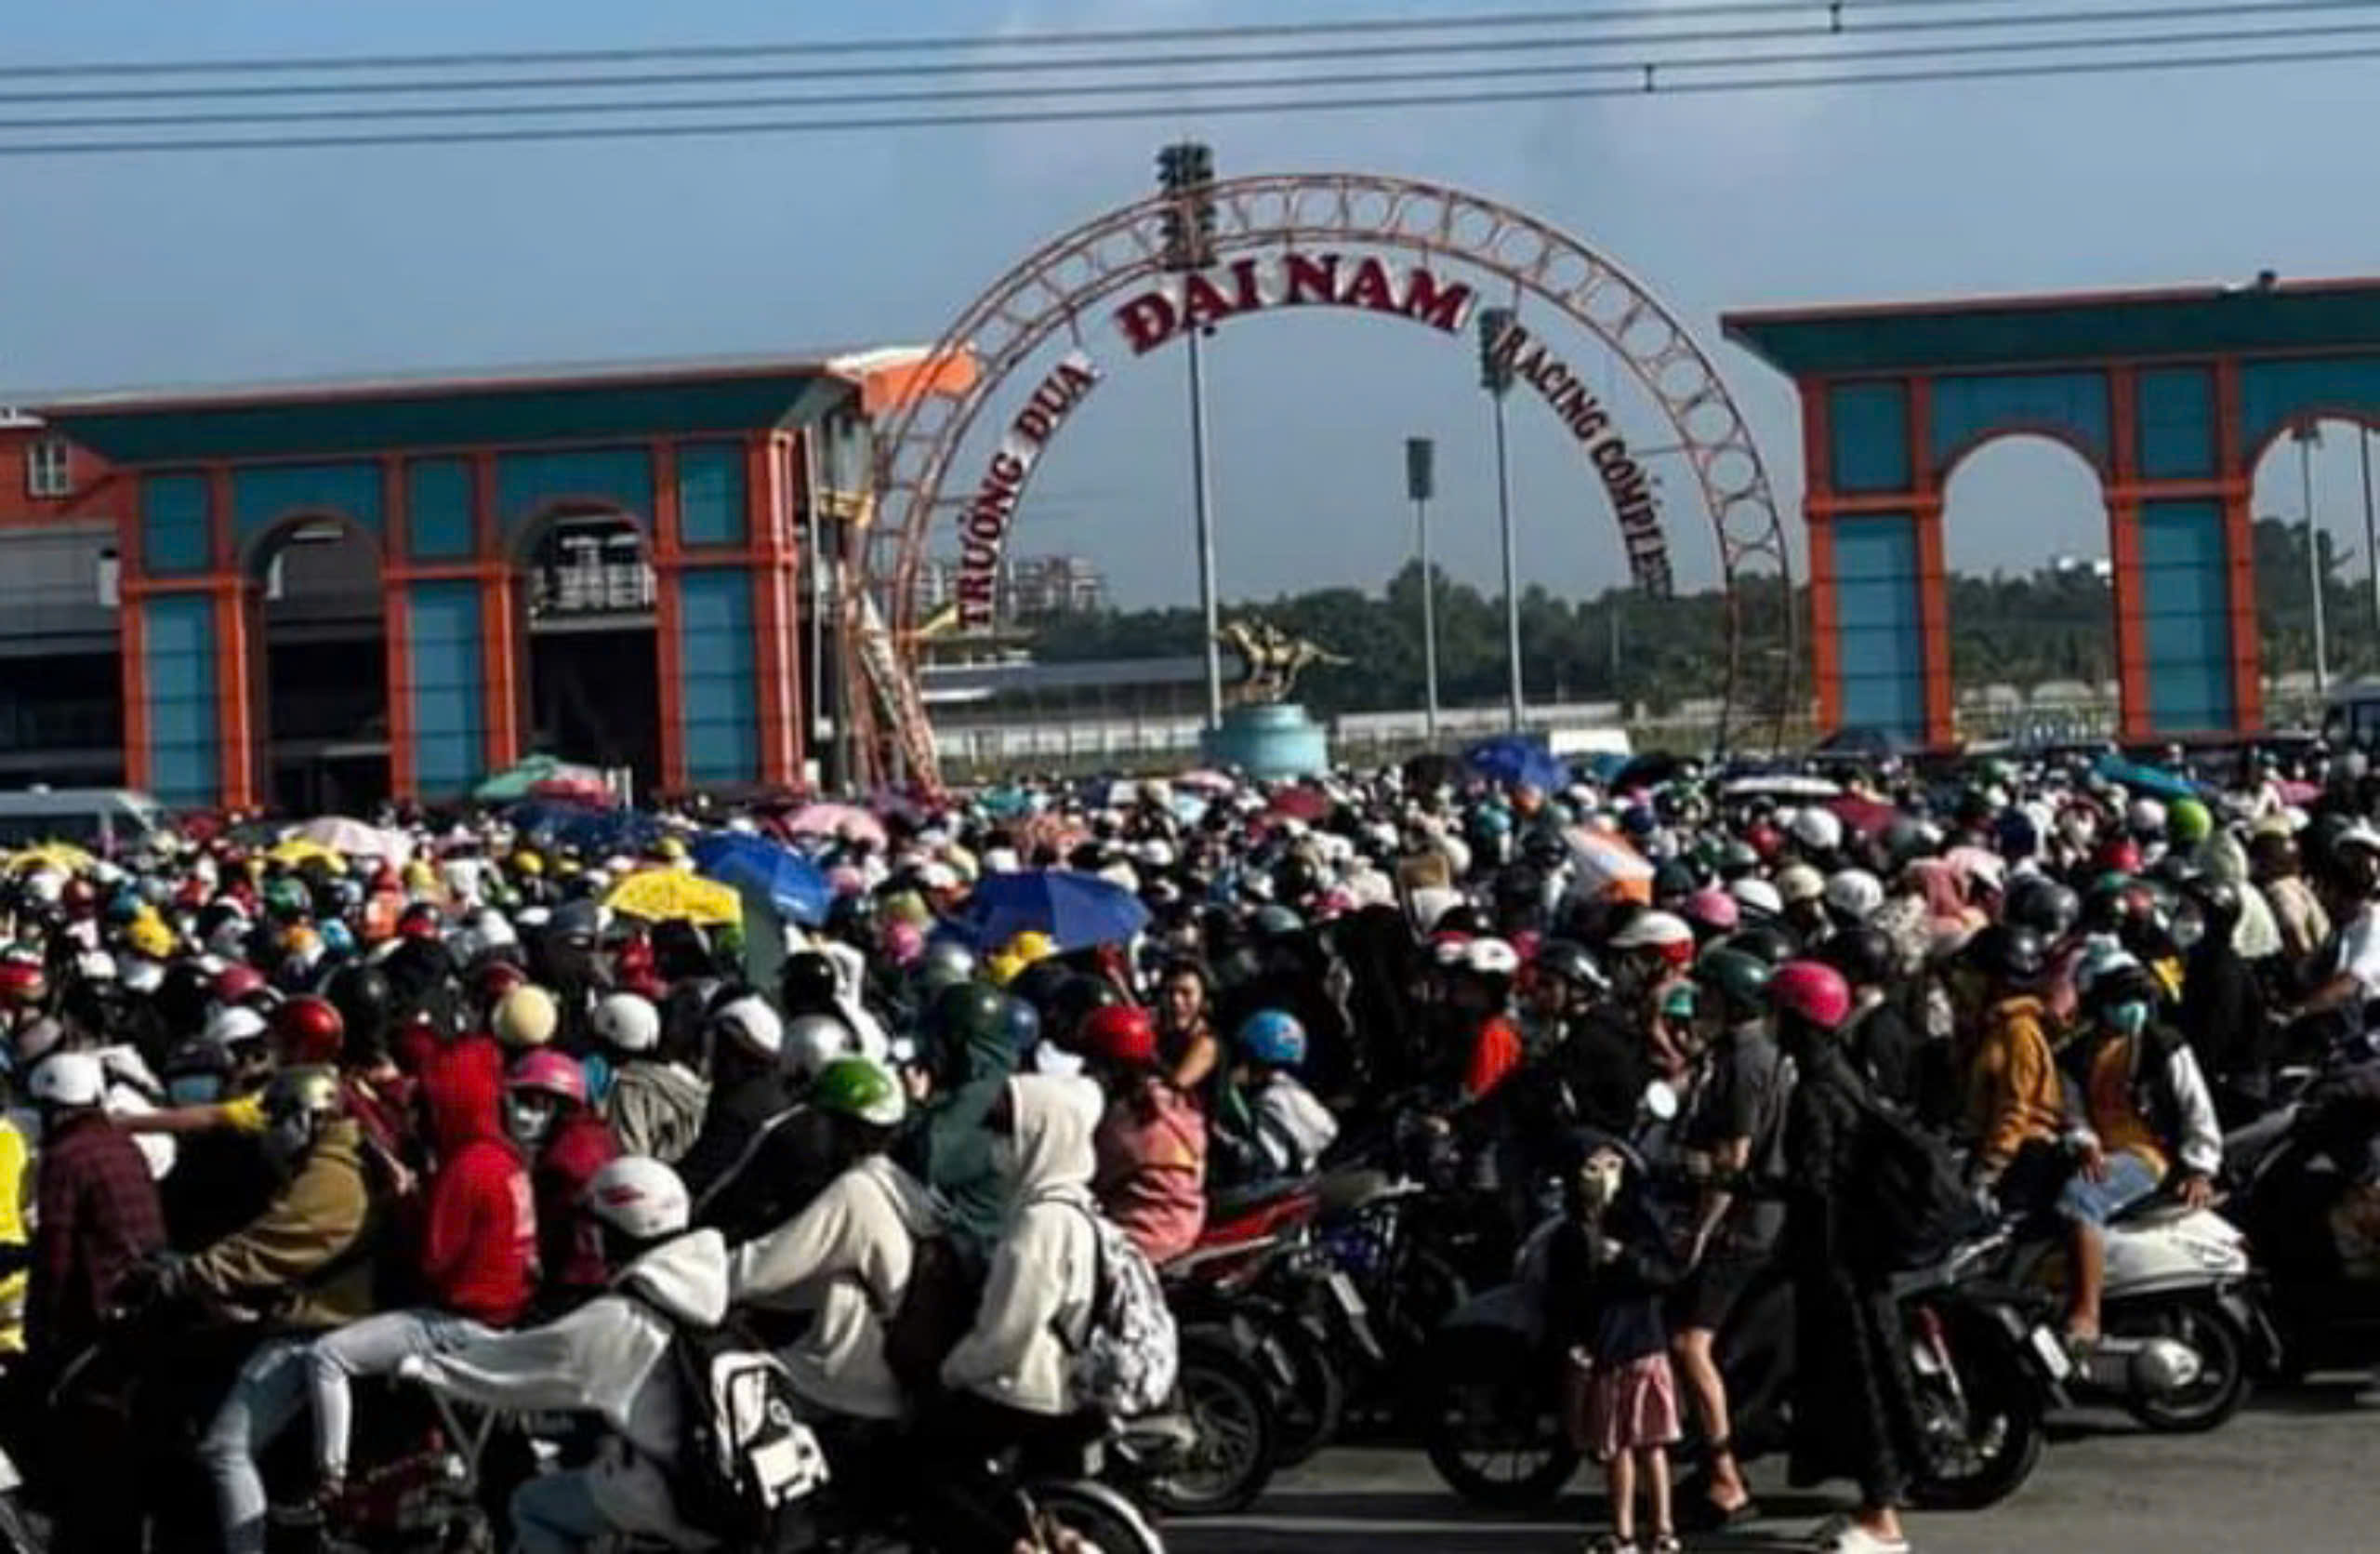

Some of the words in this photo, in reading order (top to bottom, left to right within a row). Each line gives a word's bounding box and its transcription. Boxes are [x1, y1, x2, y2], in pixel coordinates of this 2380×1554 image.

[1115, 257, 1260, 355] ĐẠI
[1282, 253, 1473, 334] NAM
[957, 452, 1023, 630] TRƯỜNG
[1490, 324, 1608, 442] RACING
[1591, 439, 1673, 598] COMPLE
